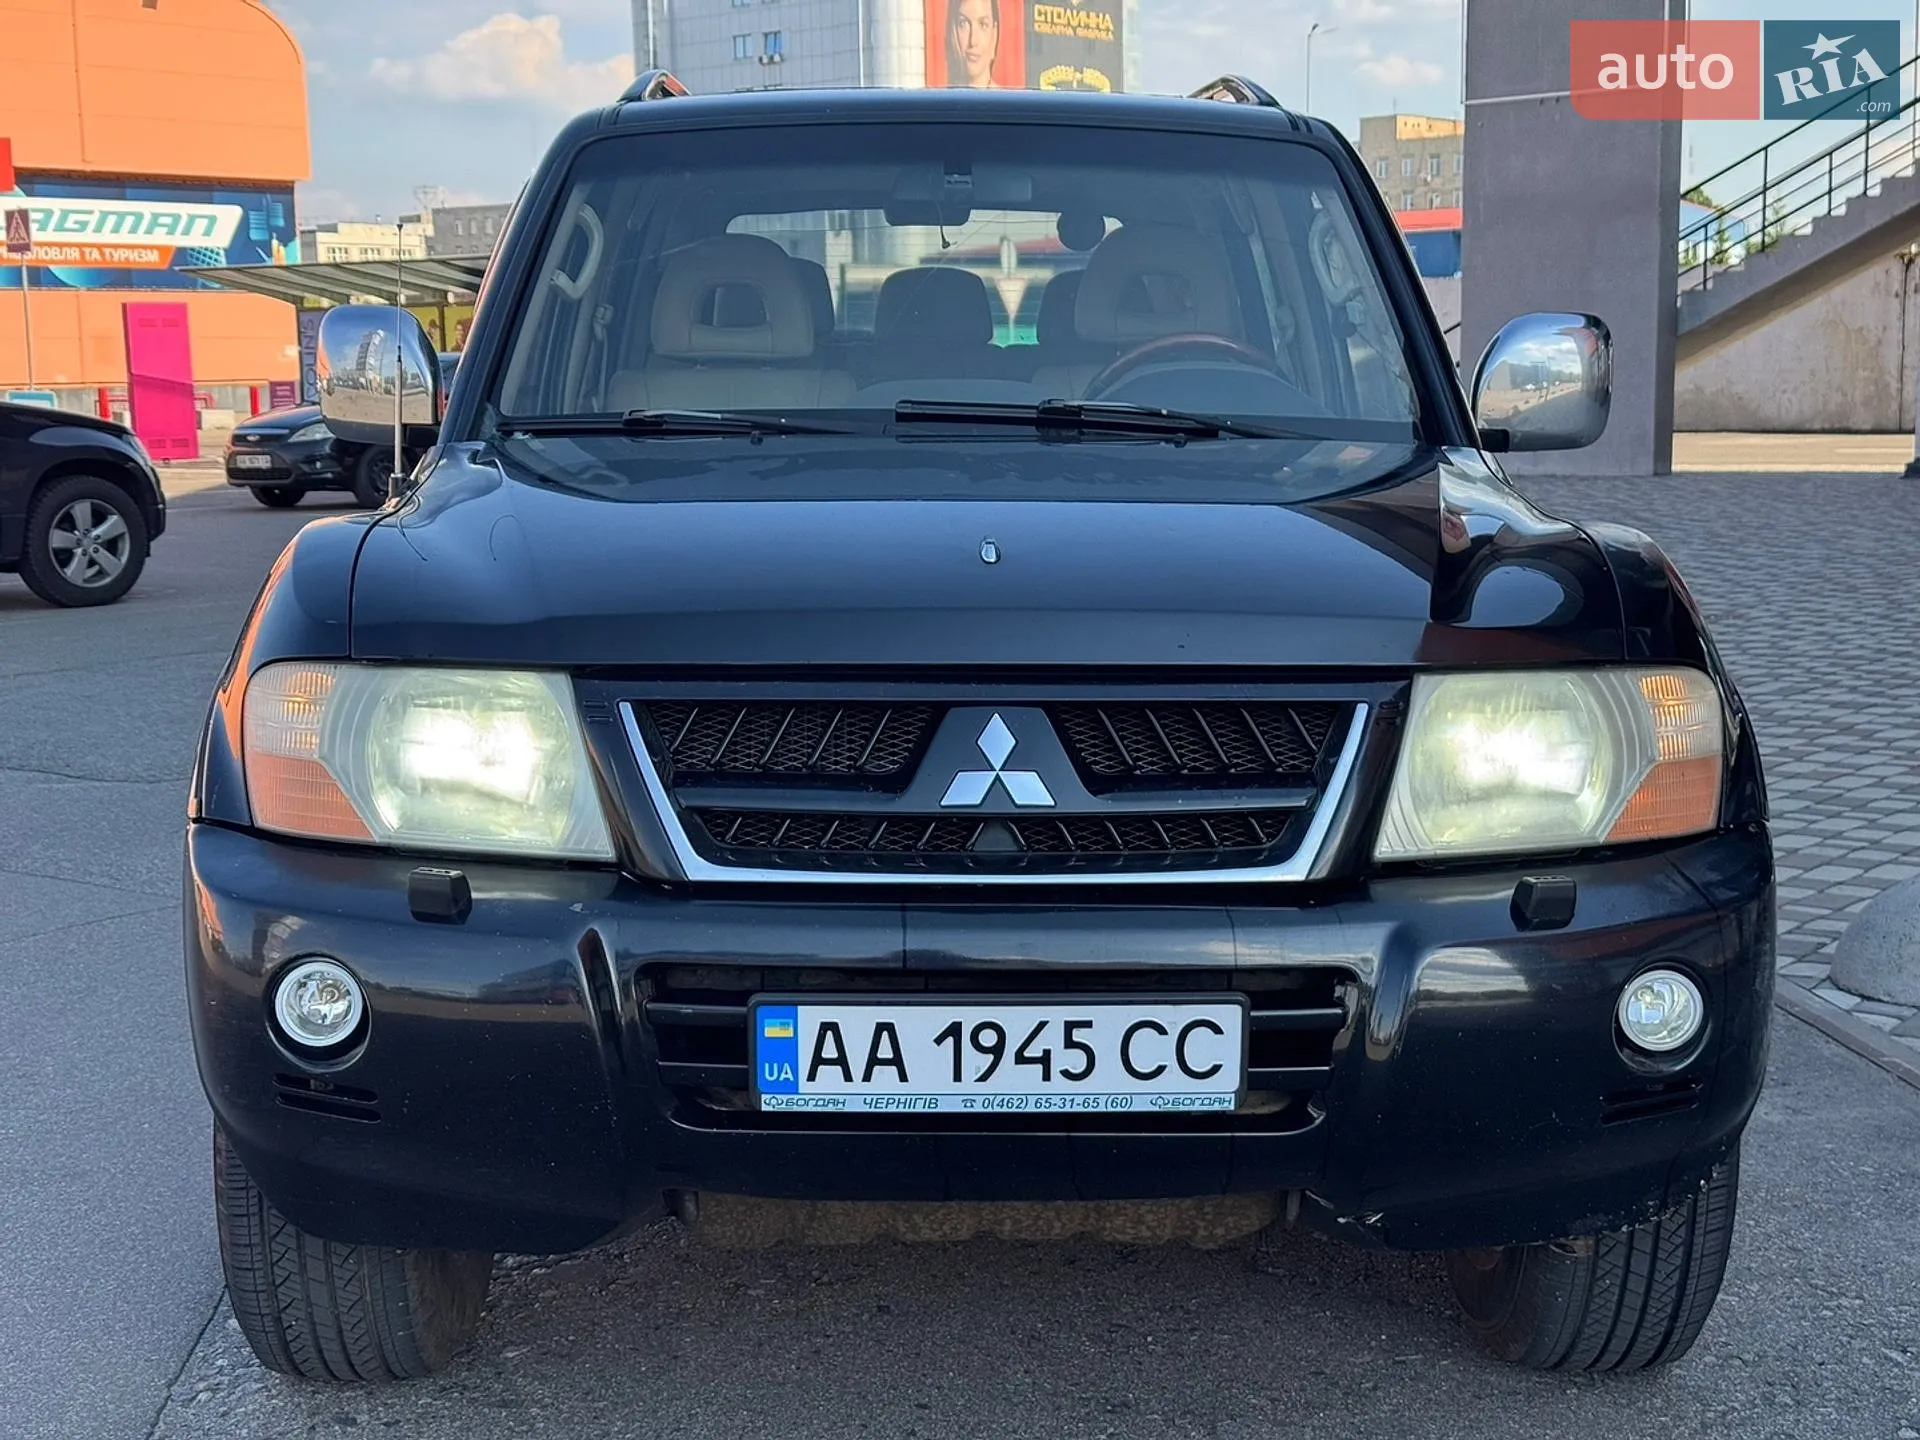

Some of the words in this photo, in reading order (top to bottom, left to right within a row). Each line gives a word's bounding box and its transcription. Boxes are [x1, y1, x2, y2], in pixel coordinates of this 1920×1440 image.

[0, 207, 218, 237] AGMAN
[84, 247, 102, 261] ТА
[104, 247, 160, 263] ТУРИЗМ
[806, 1021, 909, 1083] AA
[933, 1020, 1096, 1083] 1945
[1119, 1019, 1225, 1081] CC
[764, 1062, 794, 1081] UA
[784, 1098, 847, 1108] БОГДАН
[863, 1097, 939, 1110] ЧЕРНІГІВ
[981, 1096, 1029, 1111] 0(462)
[1034, 1096, 1100, 1110] 65-31-65
[1104, 1095, 1134, 1110] (60)
[1171, 1096, 1232, 1107] БОГДАН
